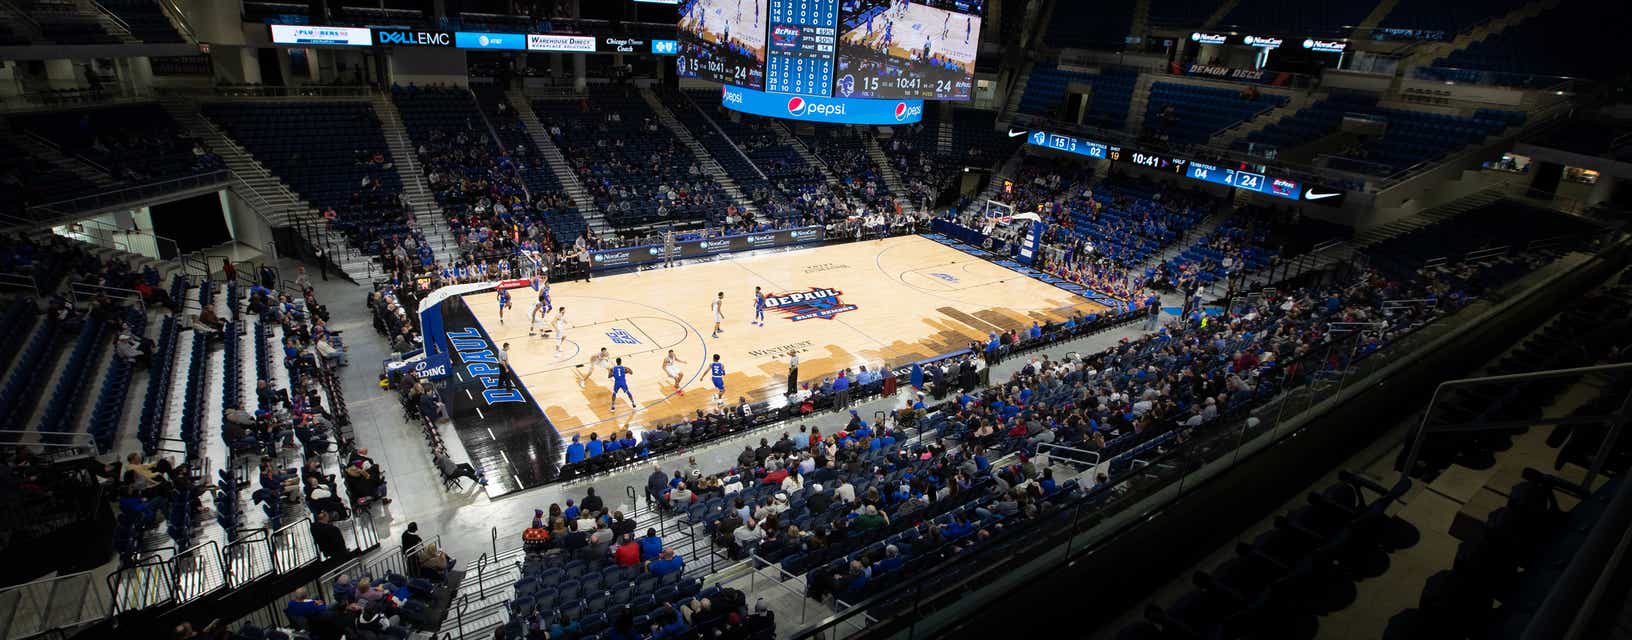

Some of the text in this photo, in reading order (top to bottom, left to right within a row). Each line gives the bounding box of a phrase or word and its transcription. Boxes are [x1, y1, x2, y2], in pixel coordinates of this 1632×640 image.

[606, 38, 627, 46] Chicago
[690, 58, 698, 71] 15
[708, 61, 724, 73] 10:41
[735, 66, 746, 80] 24
[1188, 64, 1264, 79] DEMON DECK
[864, 77, 878, 90] 15
[896, 78, 920, 89] 10:41
[936, 80, 951, 92] 24
[724, 90, 742, 104] pepsi
[807, 103, 845, 115] pepsi
[1055, 138, 1159, 167] 15 3 02 19 10:41
[1194, 169, 1207, 179] 04
[1225, 175, 1232, 184] 4
[1241, 175, 1257, 187] 24
